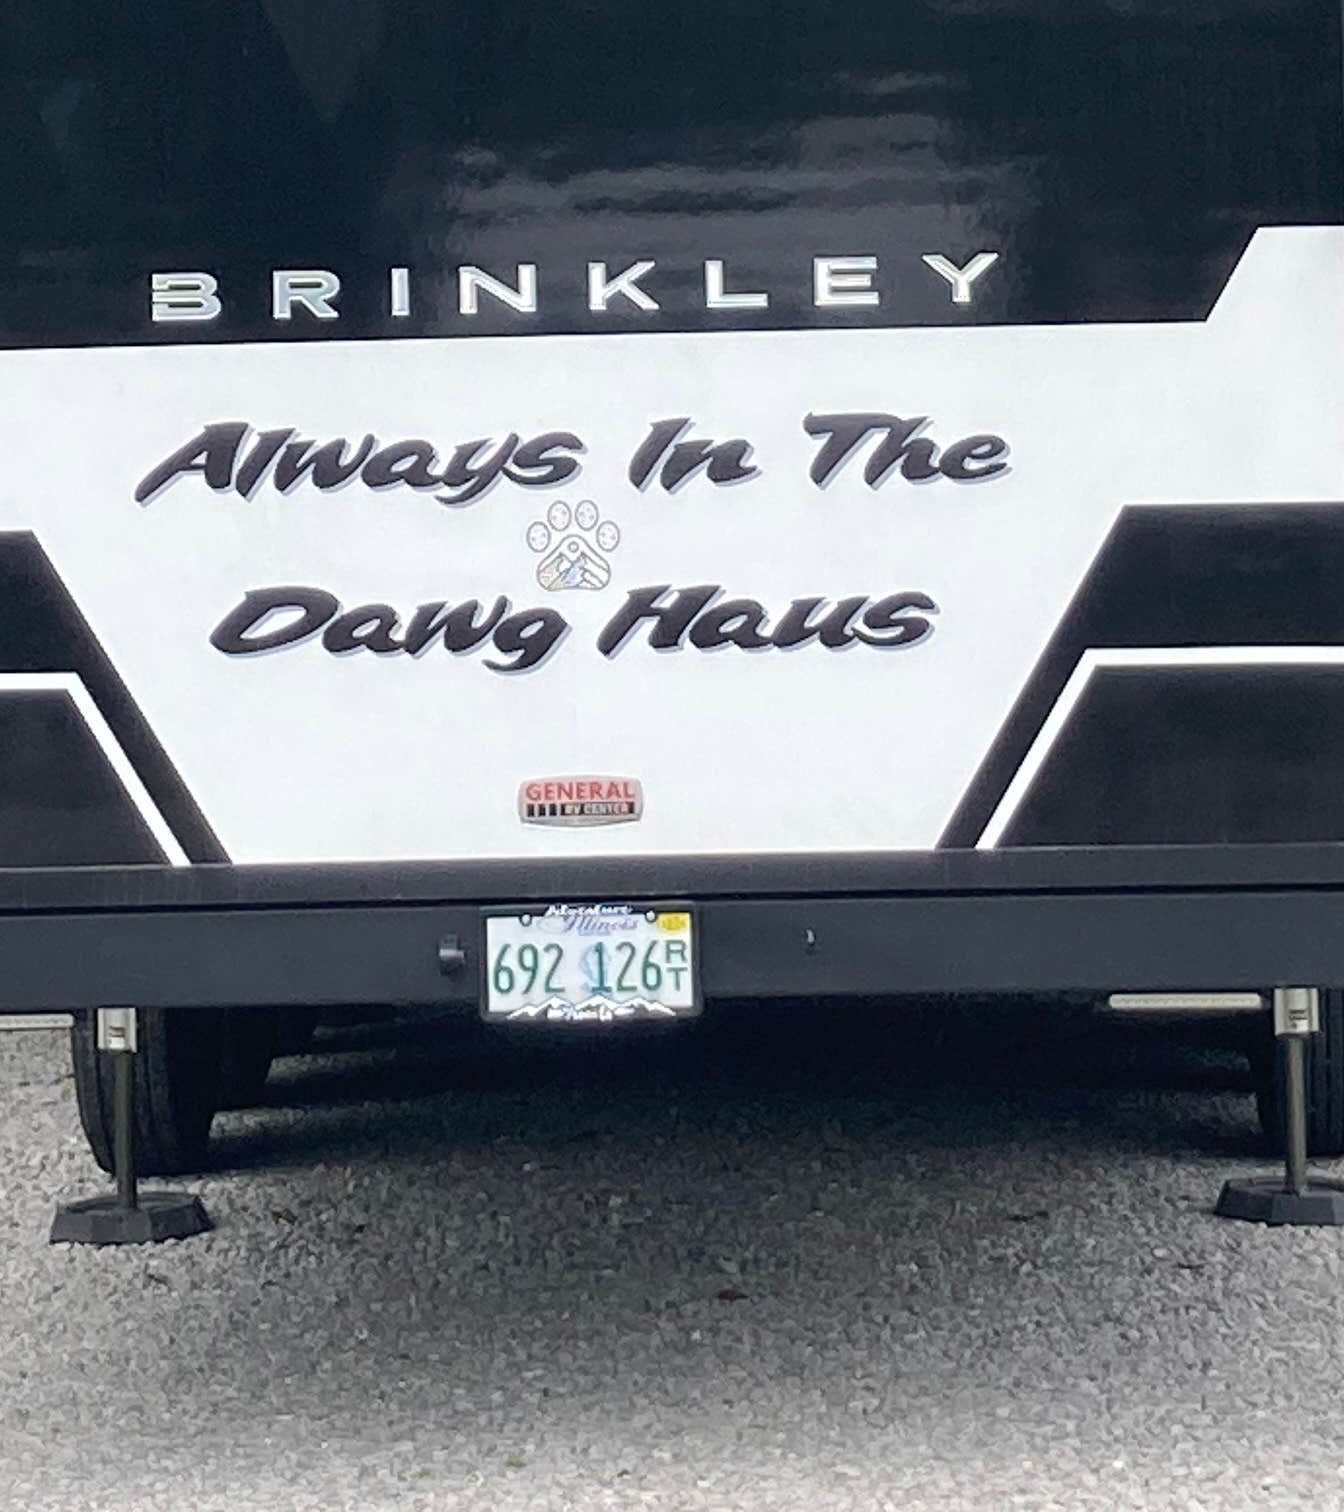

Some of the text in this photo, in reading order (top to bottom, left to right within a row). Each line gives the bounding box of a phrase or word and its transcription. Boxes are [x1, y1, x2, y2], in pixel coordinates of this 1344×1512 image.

[151, 252, 1000, 323] BRINKLEY
[134, 410, 1014, 507] Always In The
[208, 582, 940, 675] Dawg Haus
[525, 781, 636, 801] GENERAL
[562, 914, 639, 935] Illinois
[492, 940, 663, 995] 692 126
